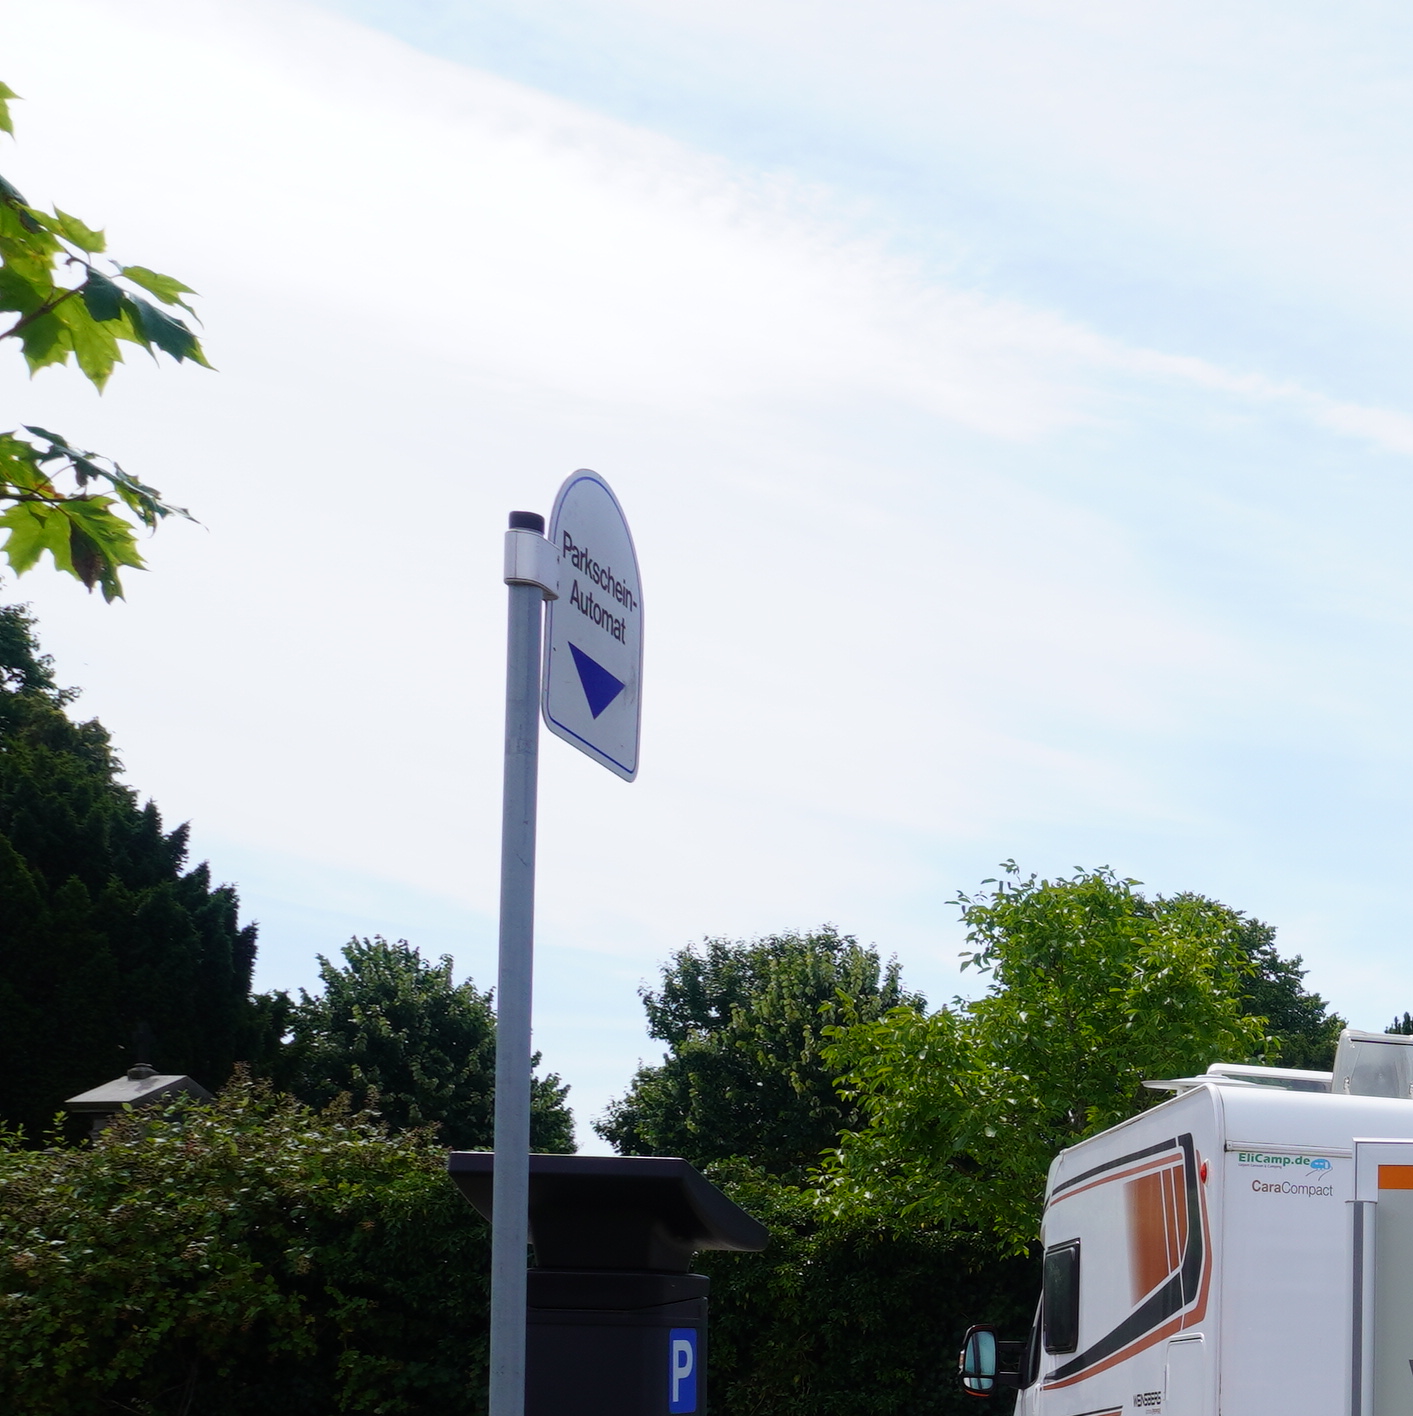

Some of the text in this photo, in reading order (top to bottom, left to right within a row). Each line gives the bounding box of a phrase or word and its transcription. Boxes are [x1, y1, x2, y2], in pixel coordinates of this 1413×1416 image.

[562, 529, 638, 612] Parkschein-
[569, 578, 627, 646] Automat
[1238, 1152, 1311, 1167] EliCamp.de
[1251, 1179, 1333, 1198] CaraCompact
[672, 1339, 693, 1403] P
